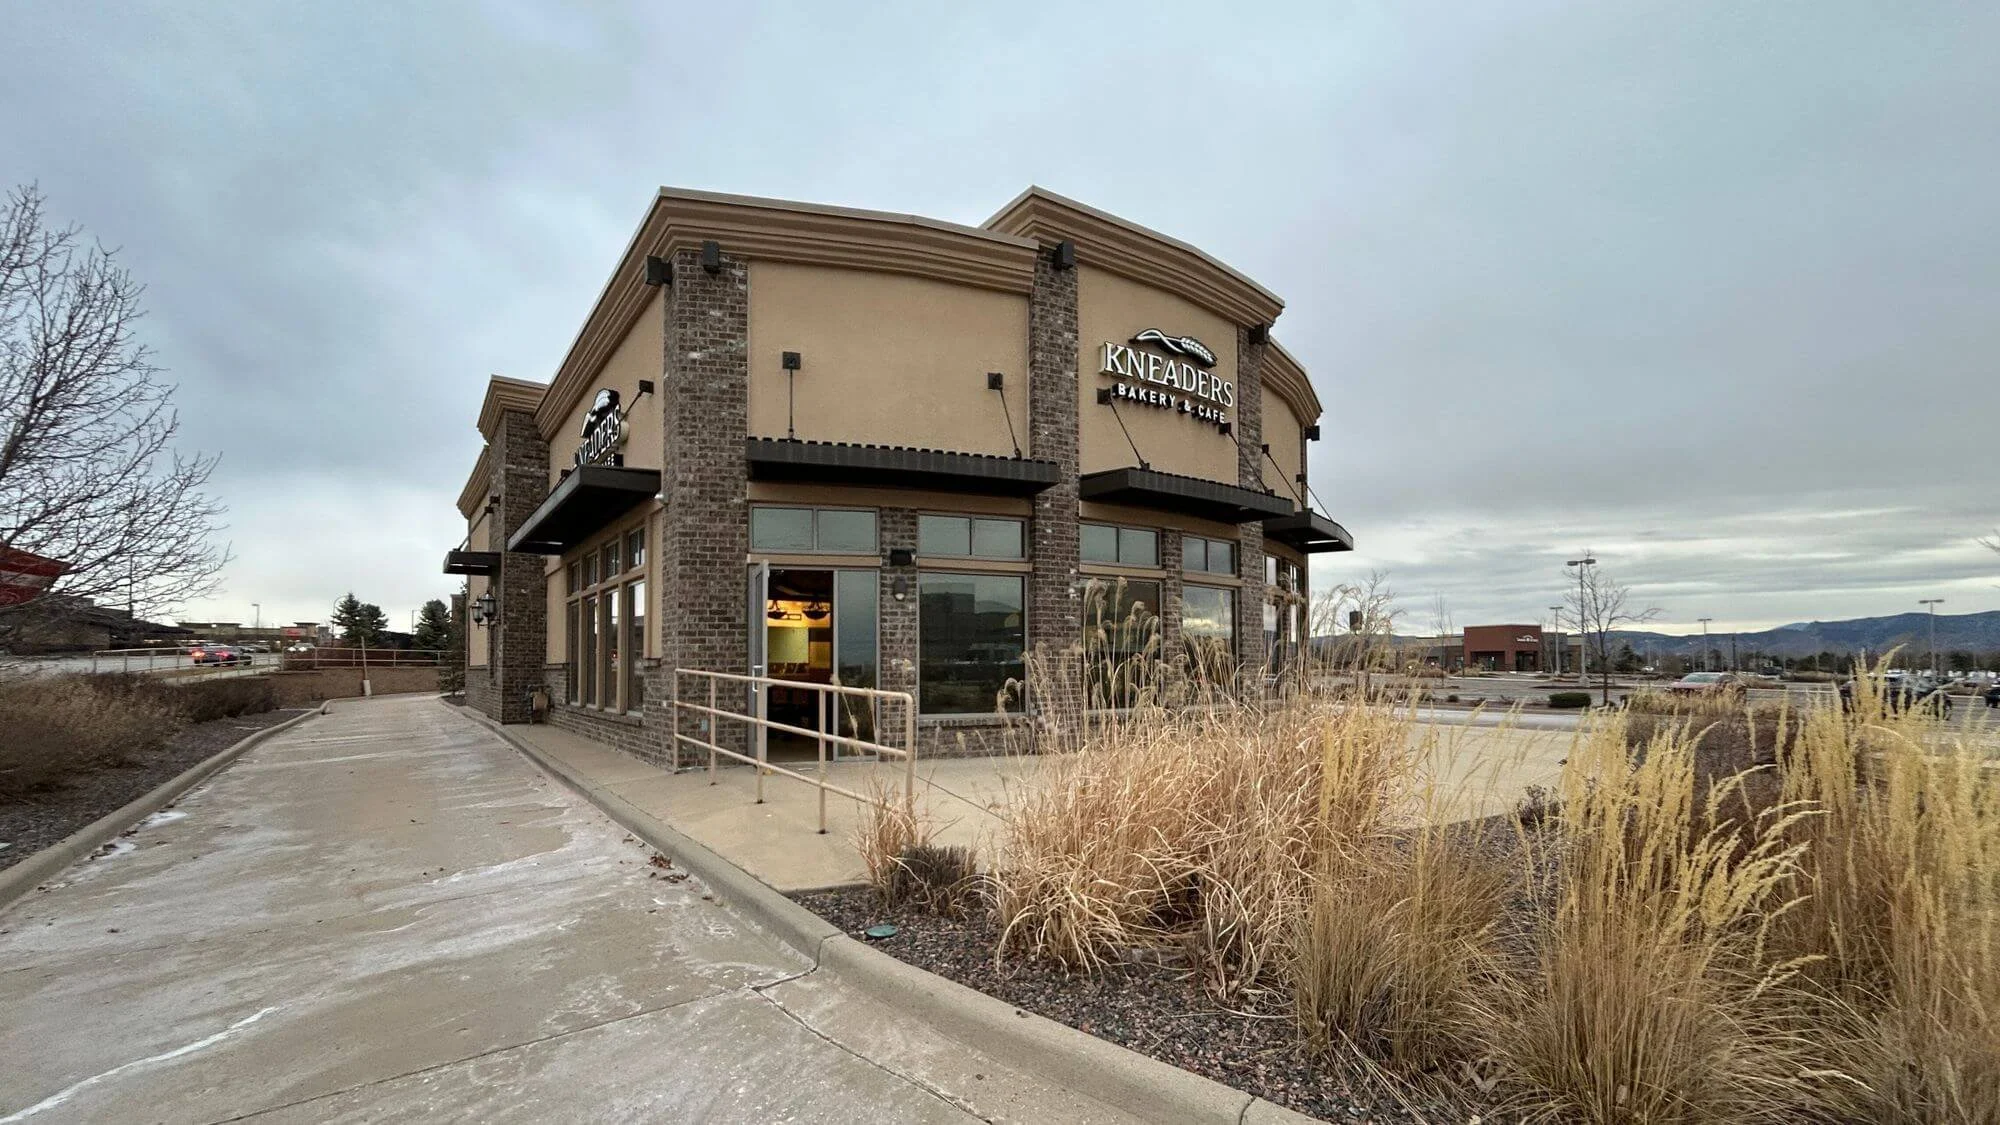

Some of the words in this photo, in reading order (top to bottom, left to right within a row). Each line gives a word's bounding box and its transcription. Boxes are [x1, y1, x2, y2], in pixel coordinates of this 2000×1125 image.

[1103, 341, 1233, 408] KNEADERS
[1117, 383, 1176, 408] BAKERY
[1183, 399, 1192, 412] &
[1198, 404, 1226, 424] CAFE
